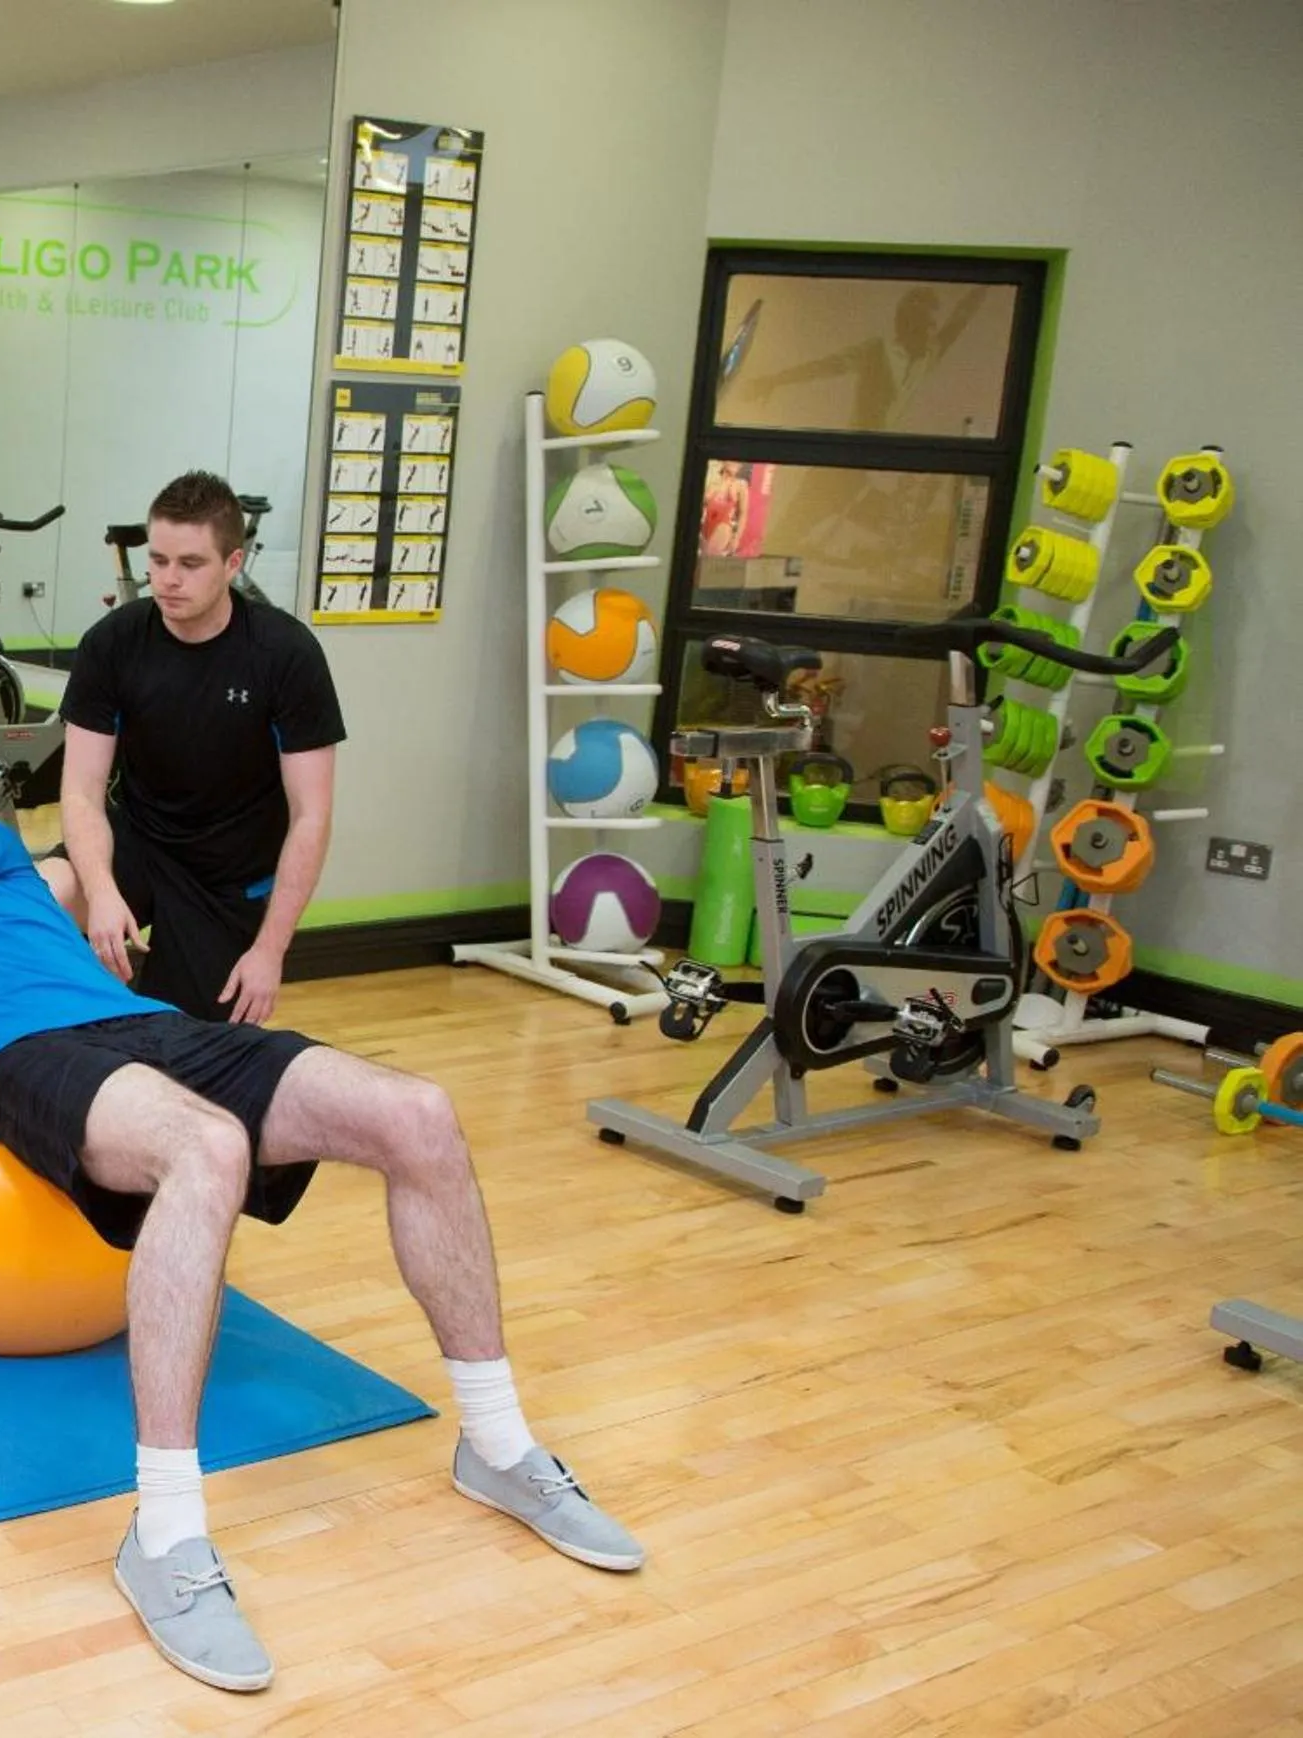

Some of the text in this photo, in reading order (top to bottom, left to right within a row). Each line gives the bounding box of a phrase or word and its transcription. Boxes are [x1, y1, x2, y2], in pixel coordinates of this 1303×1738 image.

[127, 239, 262, 294] PARK
[164, 298, 210, 323] Club
[876, 823, 957, 937] SPINNING
